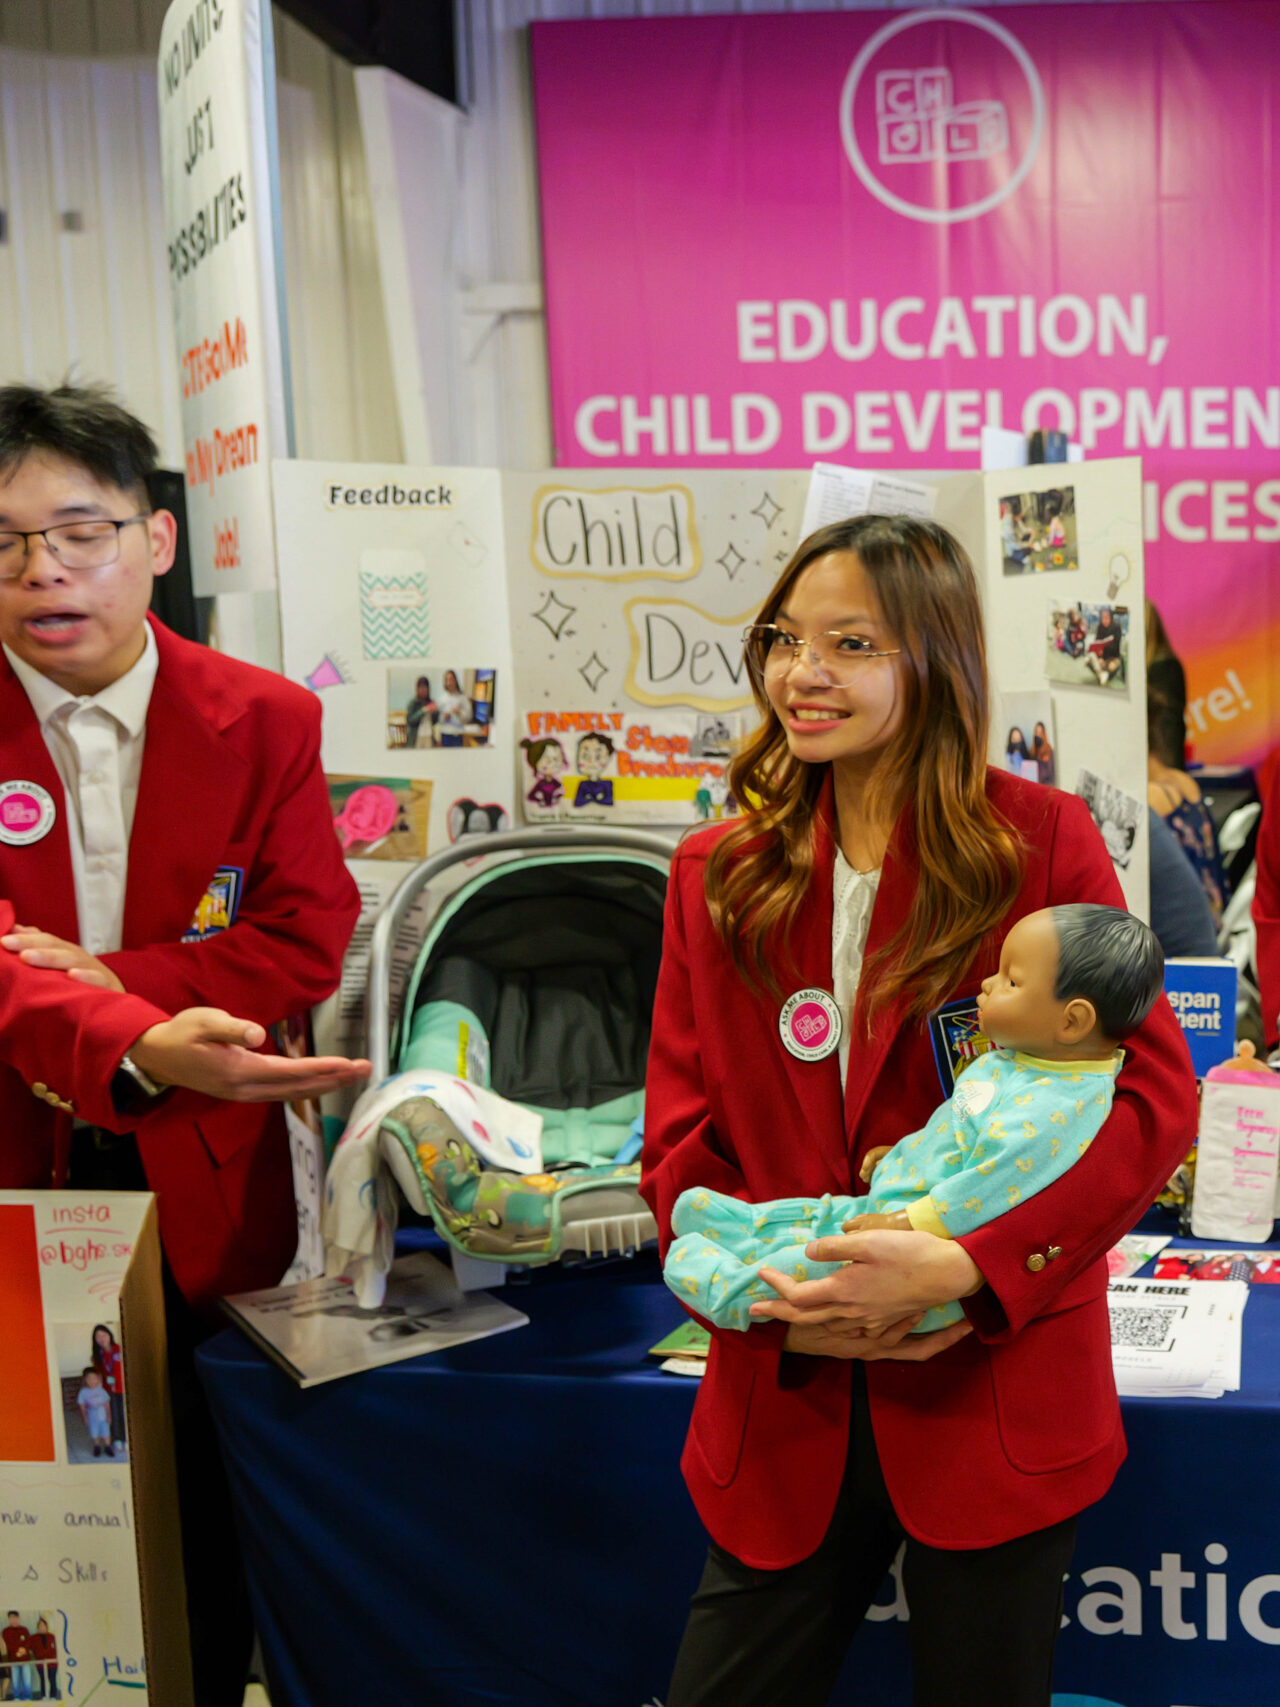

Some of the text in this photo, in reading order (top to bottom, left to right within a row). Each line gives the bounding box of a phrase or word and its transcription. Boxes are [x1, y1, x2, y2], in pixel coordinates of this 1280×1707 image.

[736, 293, 1168, 366] EDUCATION,
[574, 392, 781, 458] CHILD
[214, 423, 258, 477] Dream
[329, 484, 453, 505] Feedback
[543, 496, 682, 568] Child
[526, 711, 624, 736] FAMILY
[799, 992, 825, 1001] ABOUT
[53, 1203, 111, 1223] insta
[1144, 1285, 1191, 1296] HERE
[64, 1501, 130, 1529] annual
